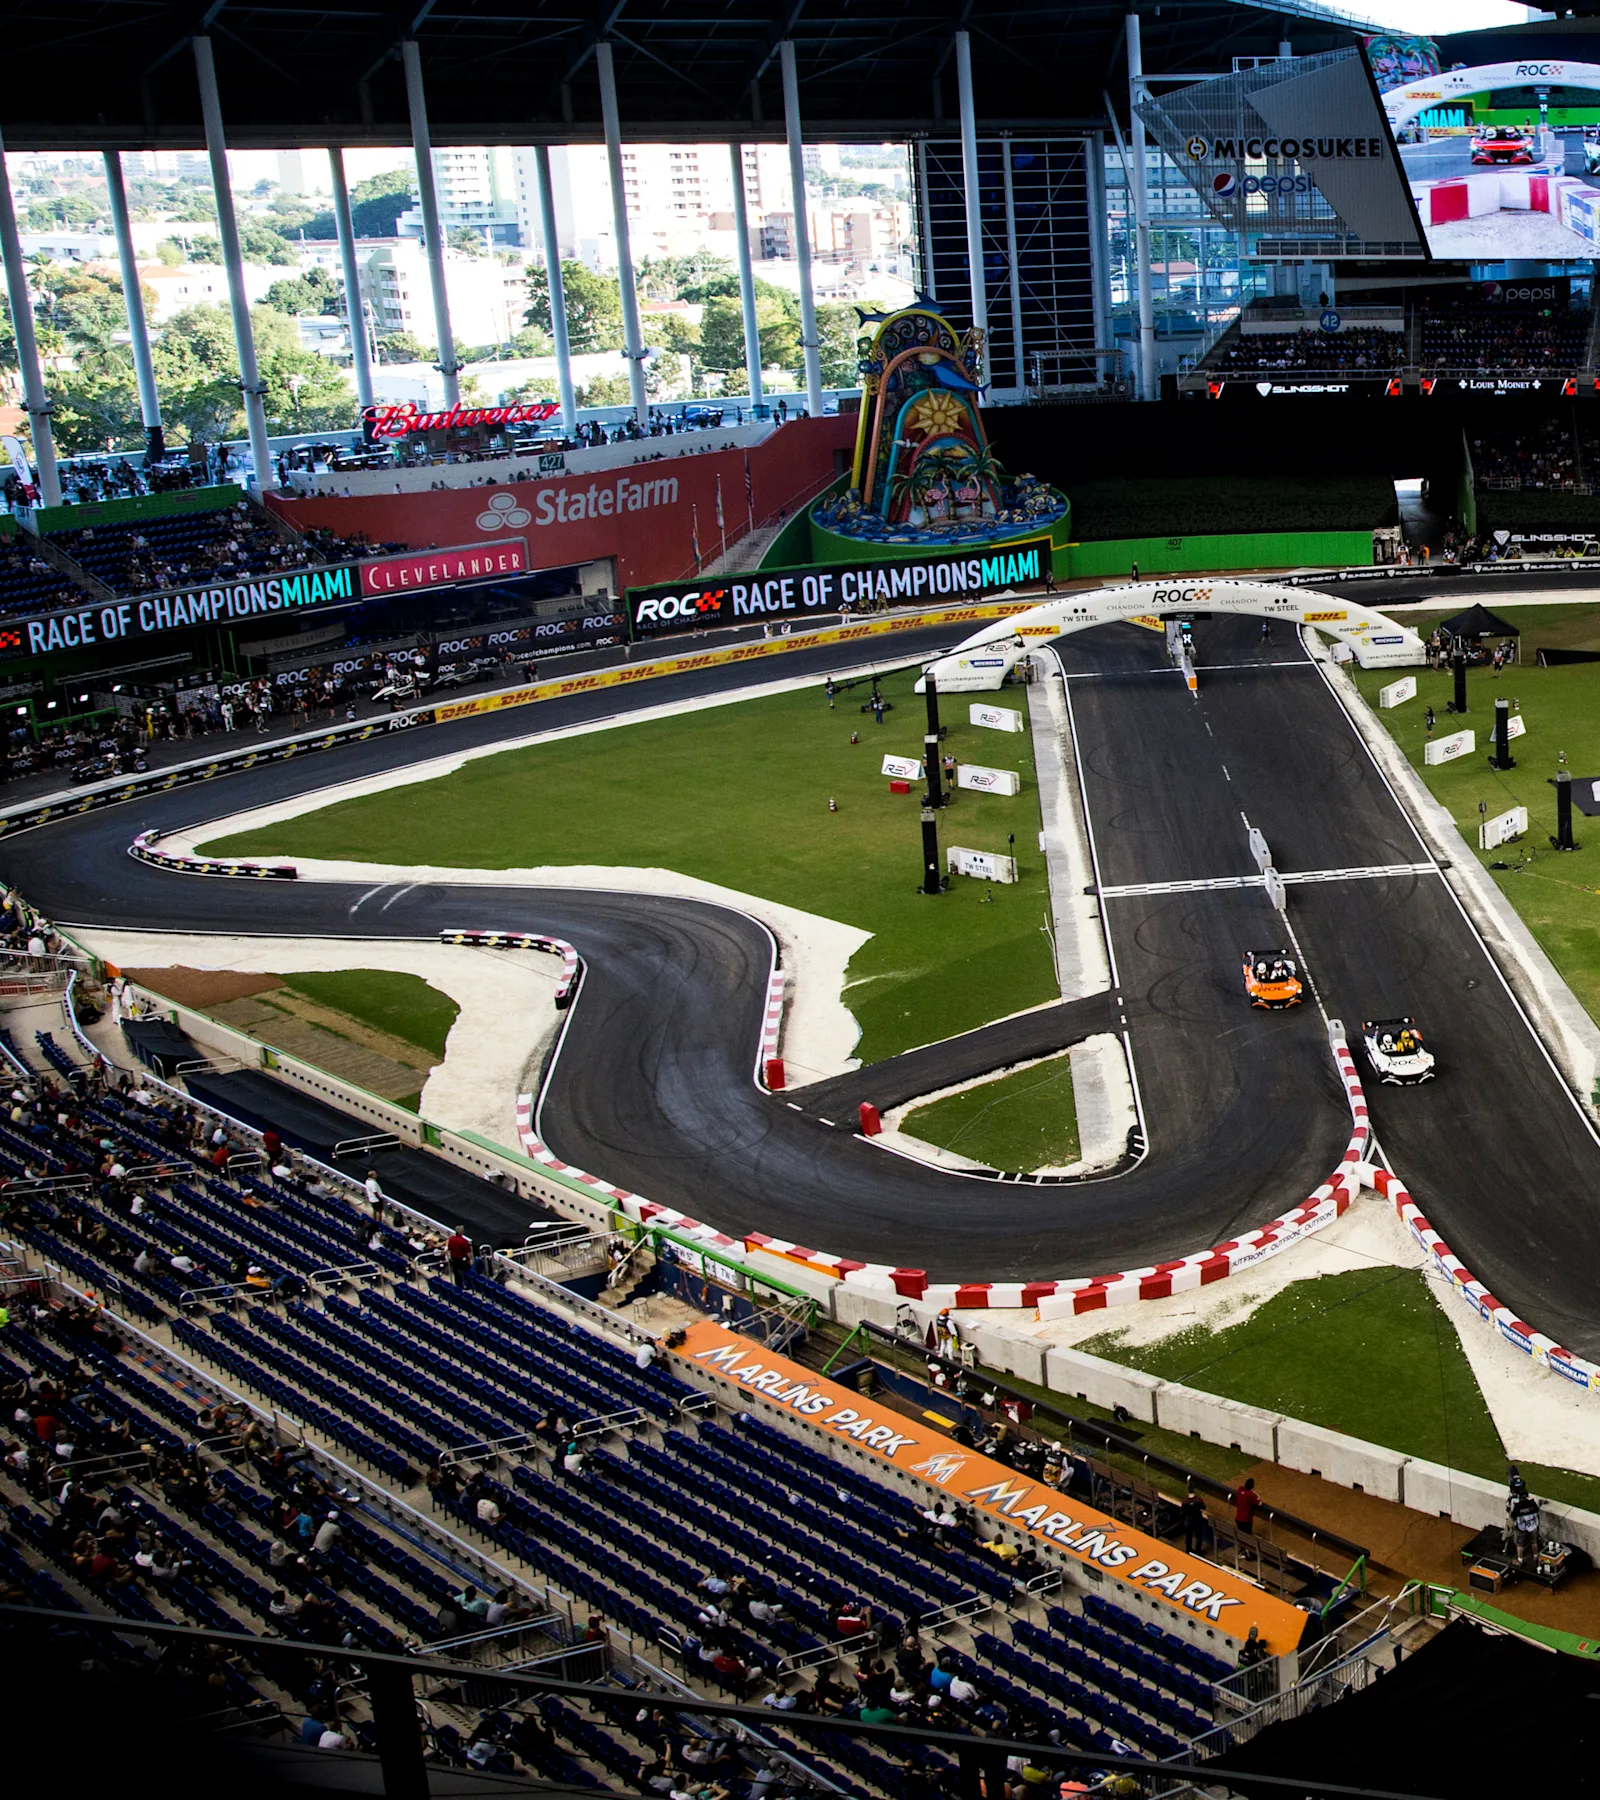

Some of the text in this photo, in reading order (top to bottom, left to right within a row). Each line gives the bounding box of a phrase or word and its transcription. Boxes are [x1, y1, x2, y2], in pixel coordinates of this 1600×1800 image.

[1515, 64, 1550, 76] ROC
[1419, 109, 1465, 127] MIAMI
[1214, 138, 1381, 158] MICCOSUKEE
[1242, 172, 1313, 197] pepsi
[1505, 286, 1557, 304] pepsi
[1322, 315, 1338, 328] 42
[1272, 384, 1350, 394] SLINGSHOT
[362, 400, 560, 440] Budweiser
[541, 456, 564, 471] 427
[1510, 534, 1596, 542] SLINGSHOT
[369, 553, 520, 590] CLEVELANDER
[732, 578, 796, 616] RACE
[802, 574, 833, 608] OF
[1152, 589, 1196, 603] ROC
[636, 593, 700, 623] ROC
[943, 610, 978, 621] DHL
[27, 612, 96, 654] RACE
[101, 605, 132, 639] OF
[535, 622, 565, 637] ROC
[582, 614, 613, 630] ROC
[890, 618, 925, 631] DHL
[488, 630, 519, 646] ROC
[838, 626, 873, 640] DHL
[1021, 627, 1054, 635] DHL
[438, 638, 470, 654] ROC
[786, 636, 821, 649] DHL
[731, 646, 768, 660] DHL
[333, 658, 364, 674] ROC
[676, 656, 714, 671] DHL
[276, 668, 309, 685] ROC
[618, 666, 656, 682] DHL
[561, 678, 600, 693] DHL
[501, 690, 539, 706] DHL
[441, 702, 480, 720] DHL
[389, 714, 418, 730] ROC
[964, 862, 993, 874] TW STEEL
[1550, 1358, 1588, 1383] MICHELIN
[692, 1341, 920, 1459] MARLINS PARK
[964, 1477, 1245, 1622] MARLINS PARK
